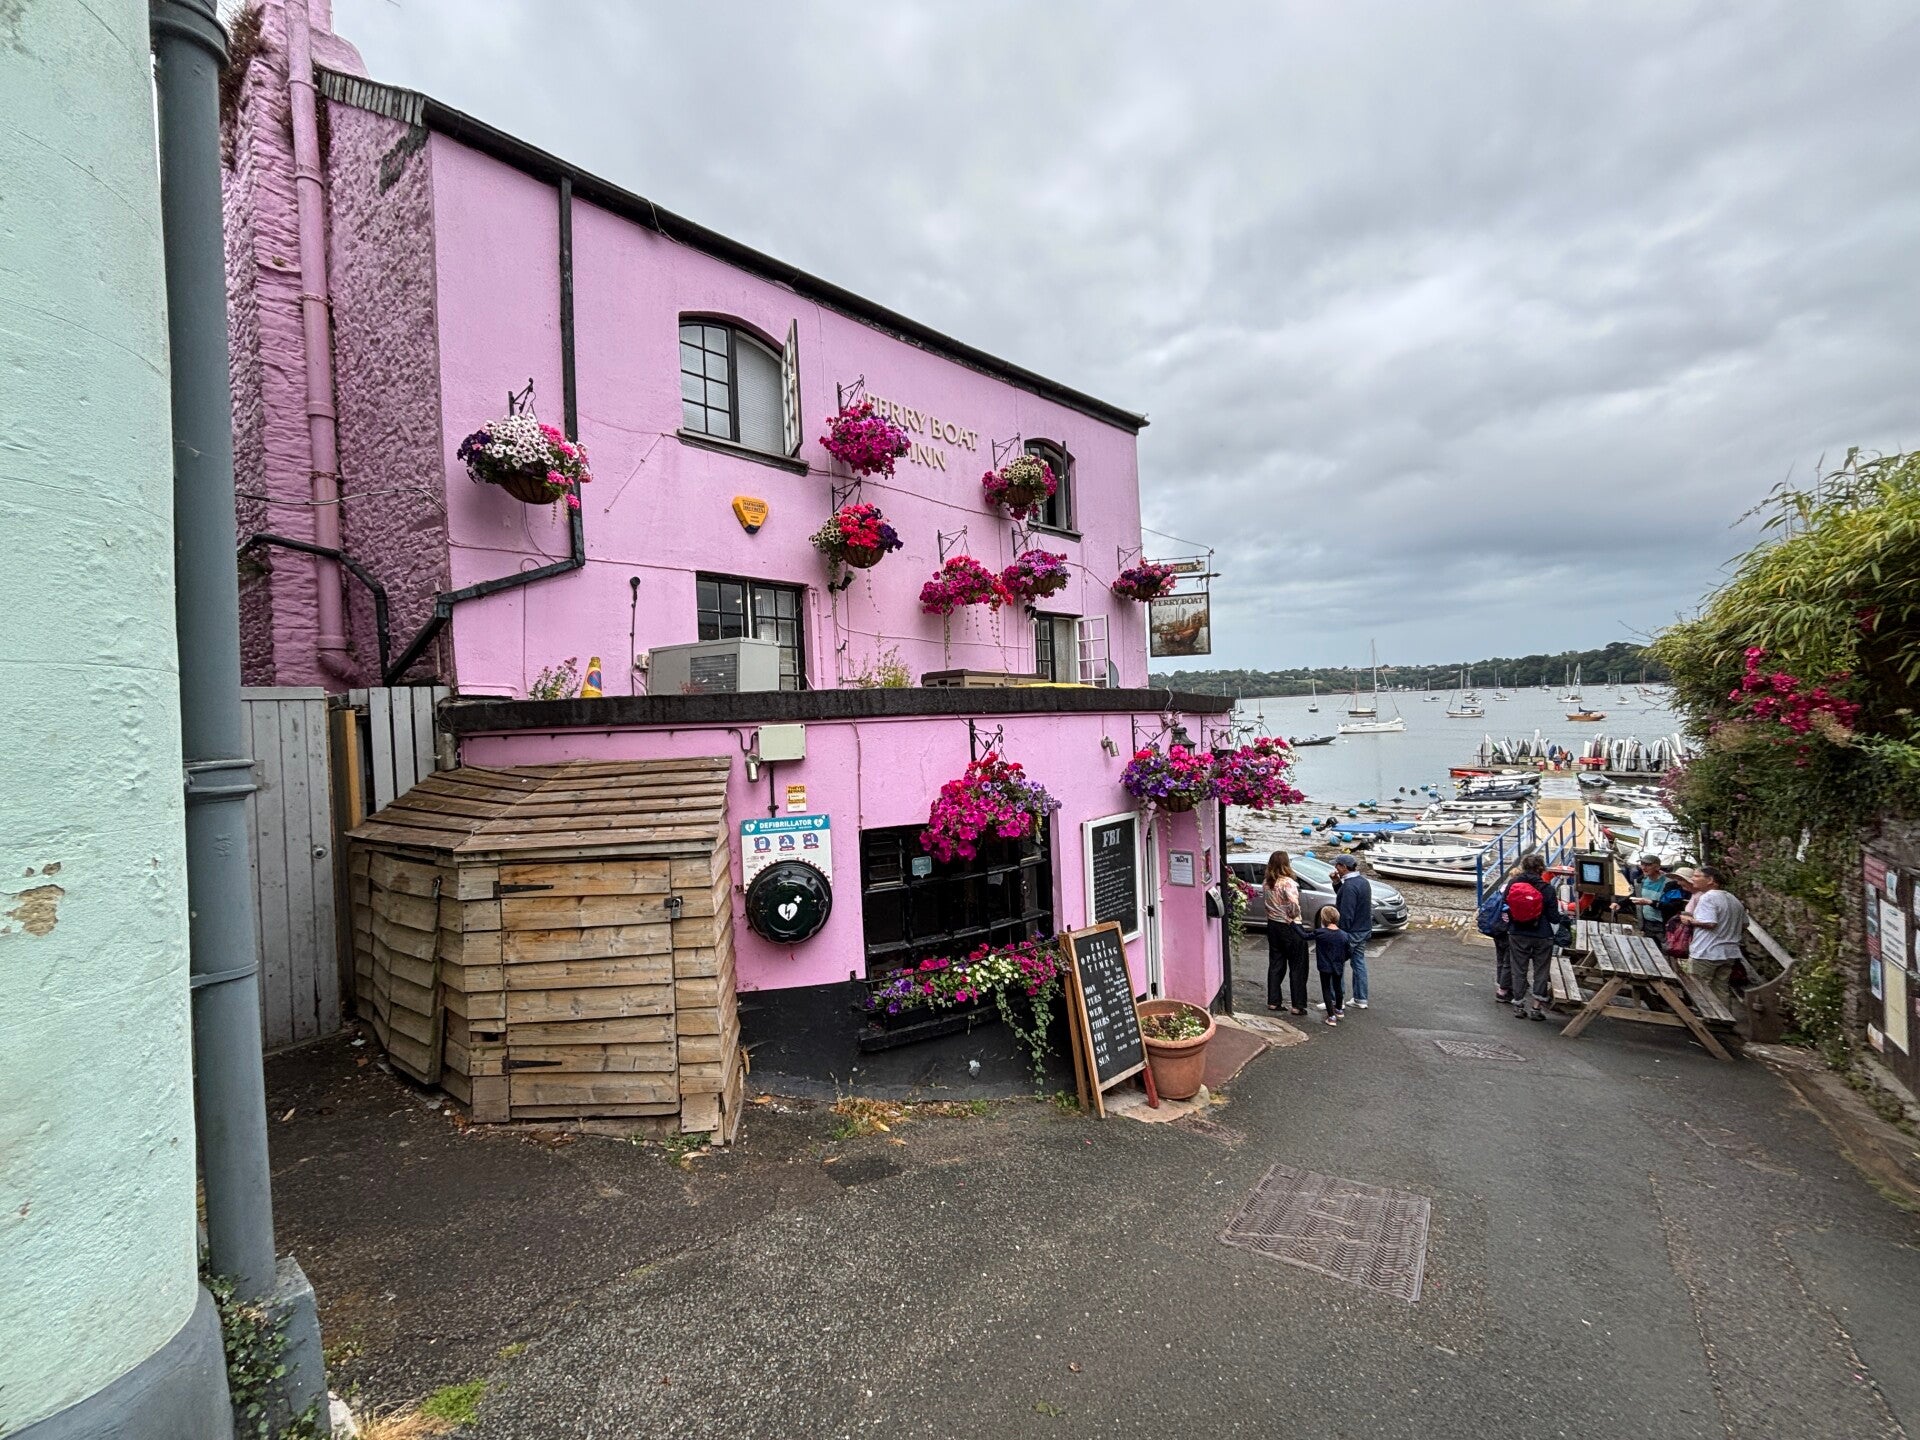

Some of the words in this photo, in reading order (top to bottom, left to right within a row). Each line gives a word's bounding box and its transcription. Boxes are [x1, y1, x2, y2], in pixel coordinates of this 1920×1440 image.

[930, 416, 978, 452] BOAT
[909, 442, 946, 472] INN
[1181, 597, 1204, 605] BOAT
[759, 819, 812, 829] DEFIBRILLATOR
[1102, 828, 1121, 848] FBI
[1090, 940, 1105, 952] FBI
[1080, 946, 1118, 965] OPENING
[1087, 957, 1114, 973] TIMES
[1084, 984, 1096, 996] MON
[1087, 993, 1102, 1007] TUES
[1091, 1015, 1110, 1030] THURS
[1094, 1031, 1104, 1043] FRI
[1096, 1042, 1107, 1055] SAT
[1098, 1054, 1110, 1067] SUN
